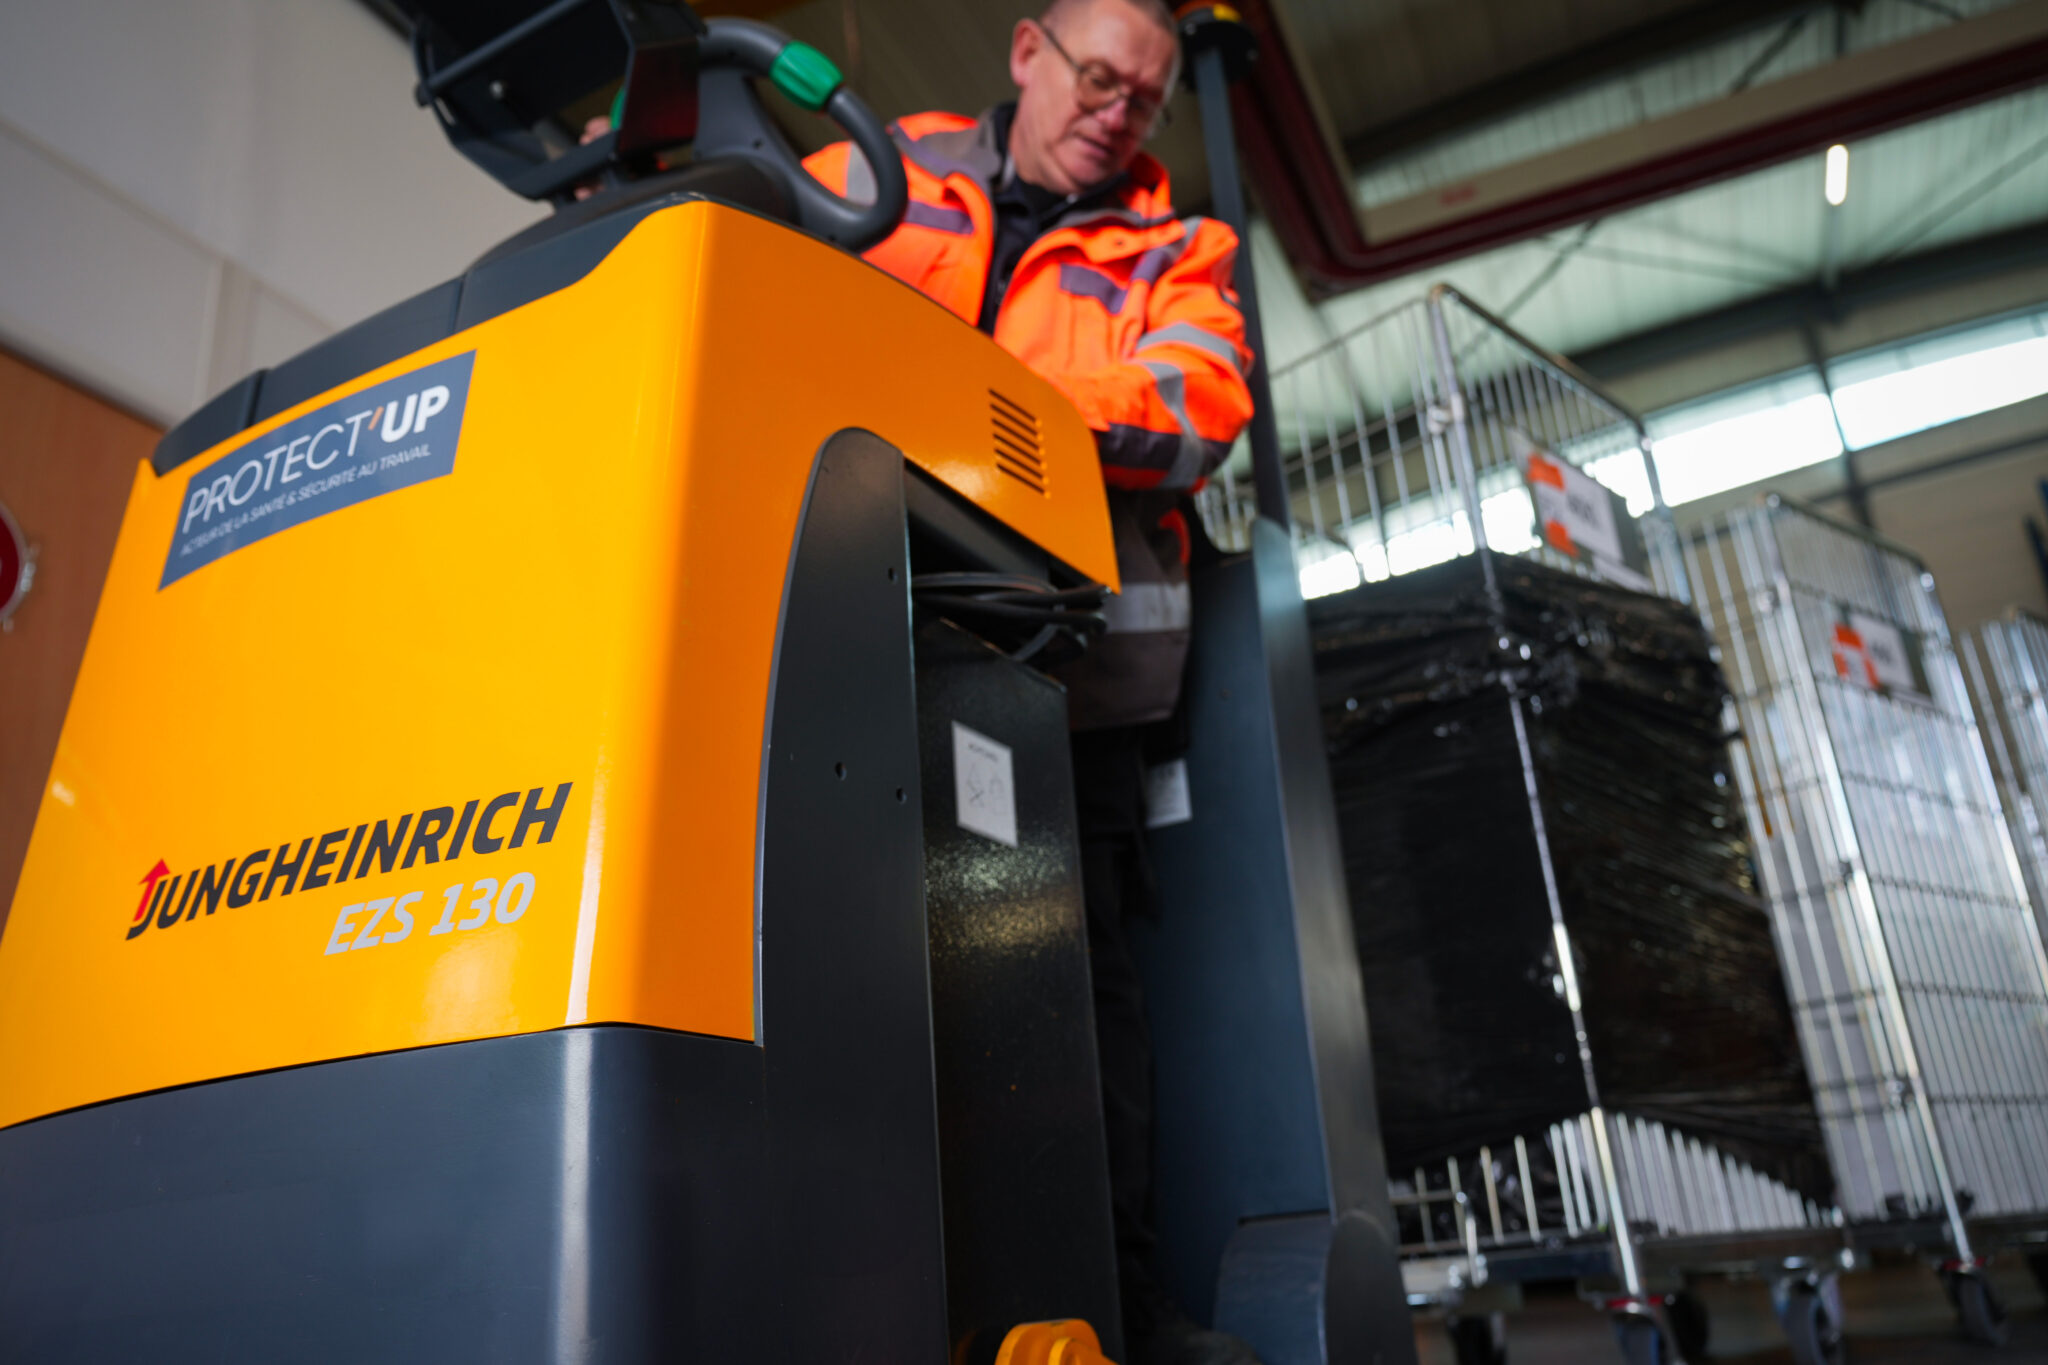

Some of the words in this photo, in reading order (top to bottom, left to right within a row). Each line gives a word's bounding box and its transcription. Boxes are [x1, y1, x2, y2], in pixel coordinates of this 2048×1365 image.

[182, 385, 451, 534] PROTECT'UP
[357, 460, 379, 478] AU
[379, 444, 432, 471] TRAVAIL
[125, 781, 574, 941] JUNGHEINRICH
[323, 890, 424, 956] EZS
[428, 871, 536, 937] 130
